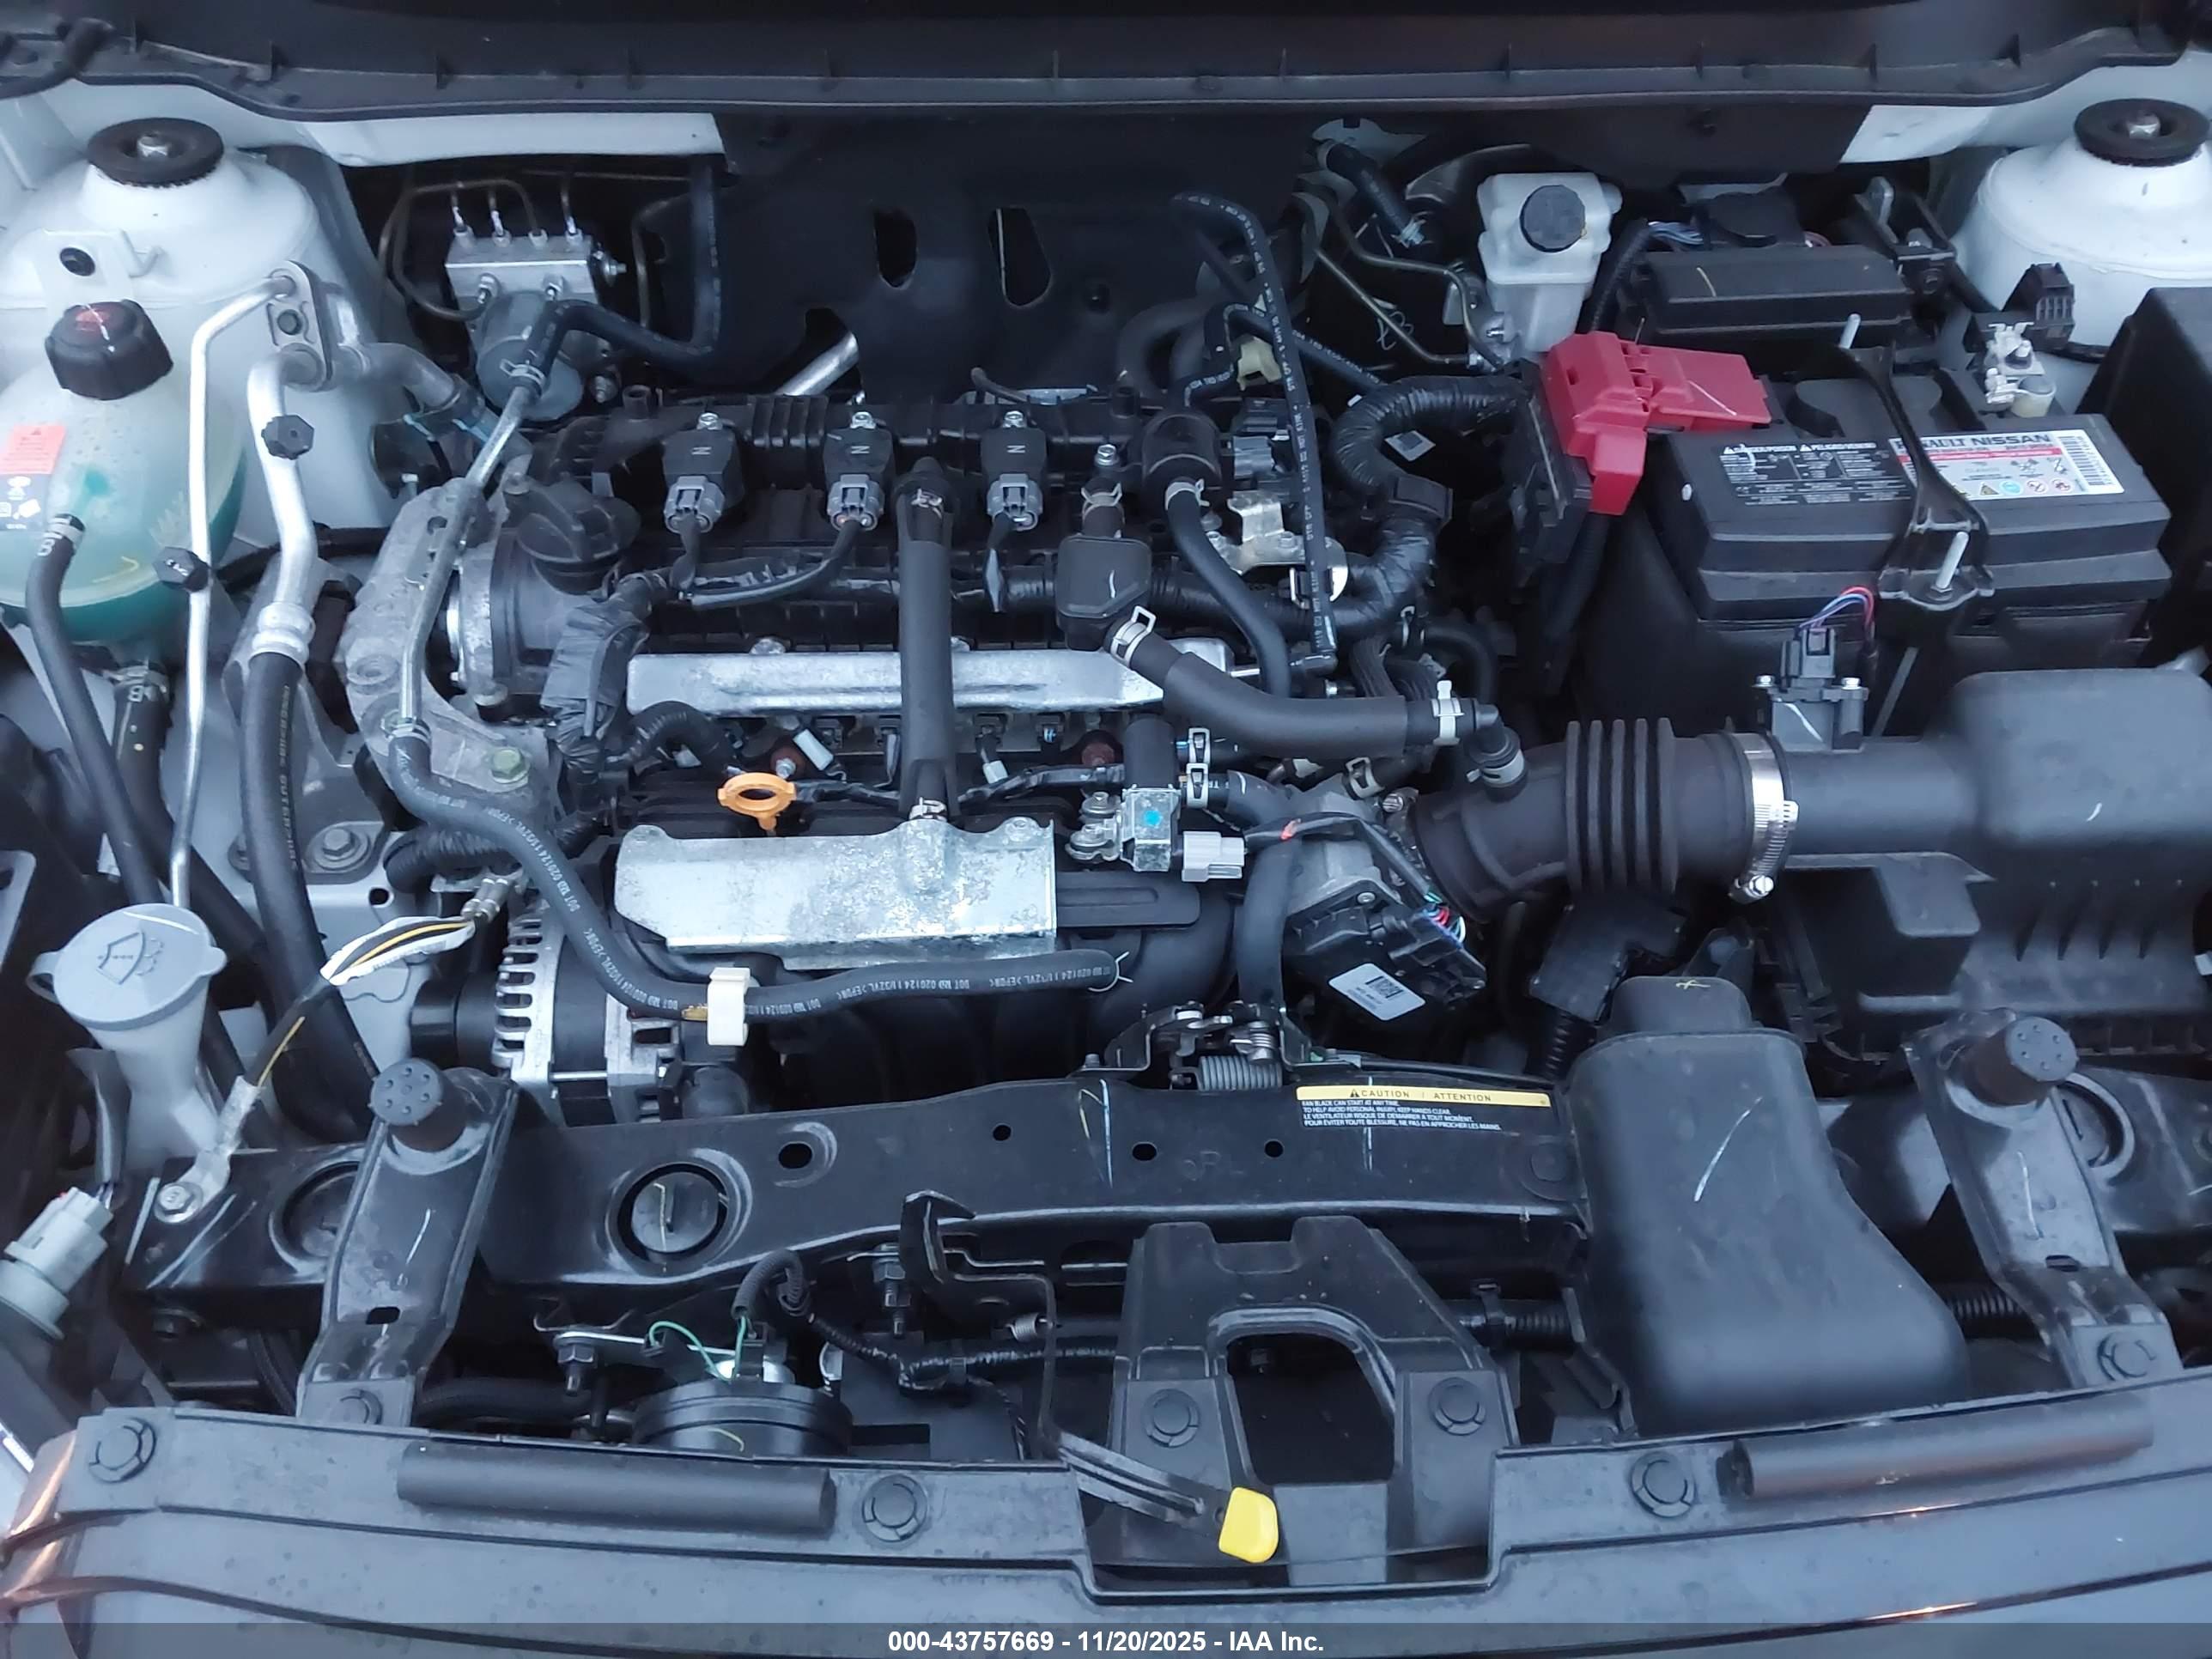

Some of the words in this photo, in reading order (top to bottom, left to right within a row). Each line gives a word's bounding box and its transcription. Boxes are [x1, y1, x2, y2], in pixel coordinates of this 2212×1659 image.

[1894, 438, 1966, 449] RAULT
[1974, 433, 2051, 446] NISSAN
[1433, 1092, 1492, 1102] ATTENTION
